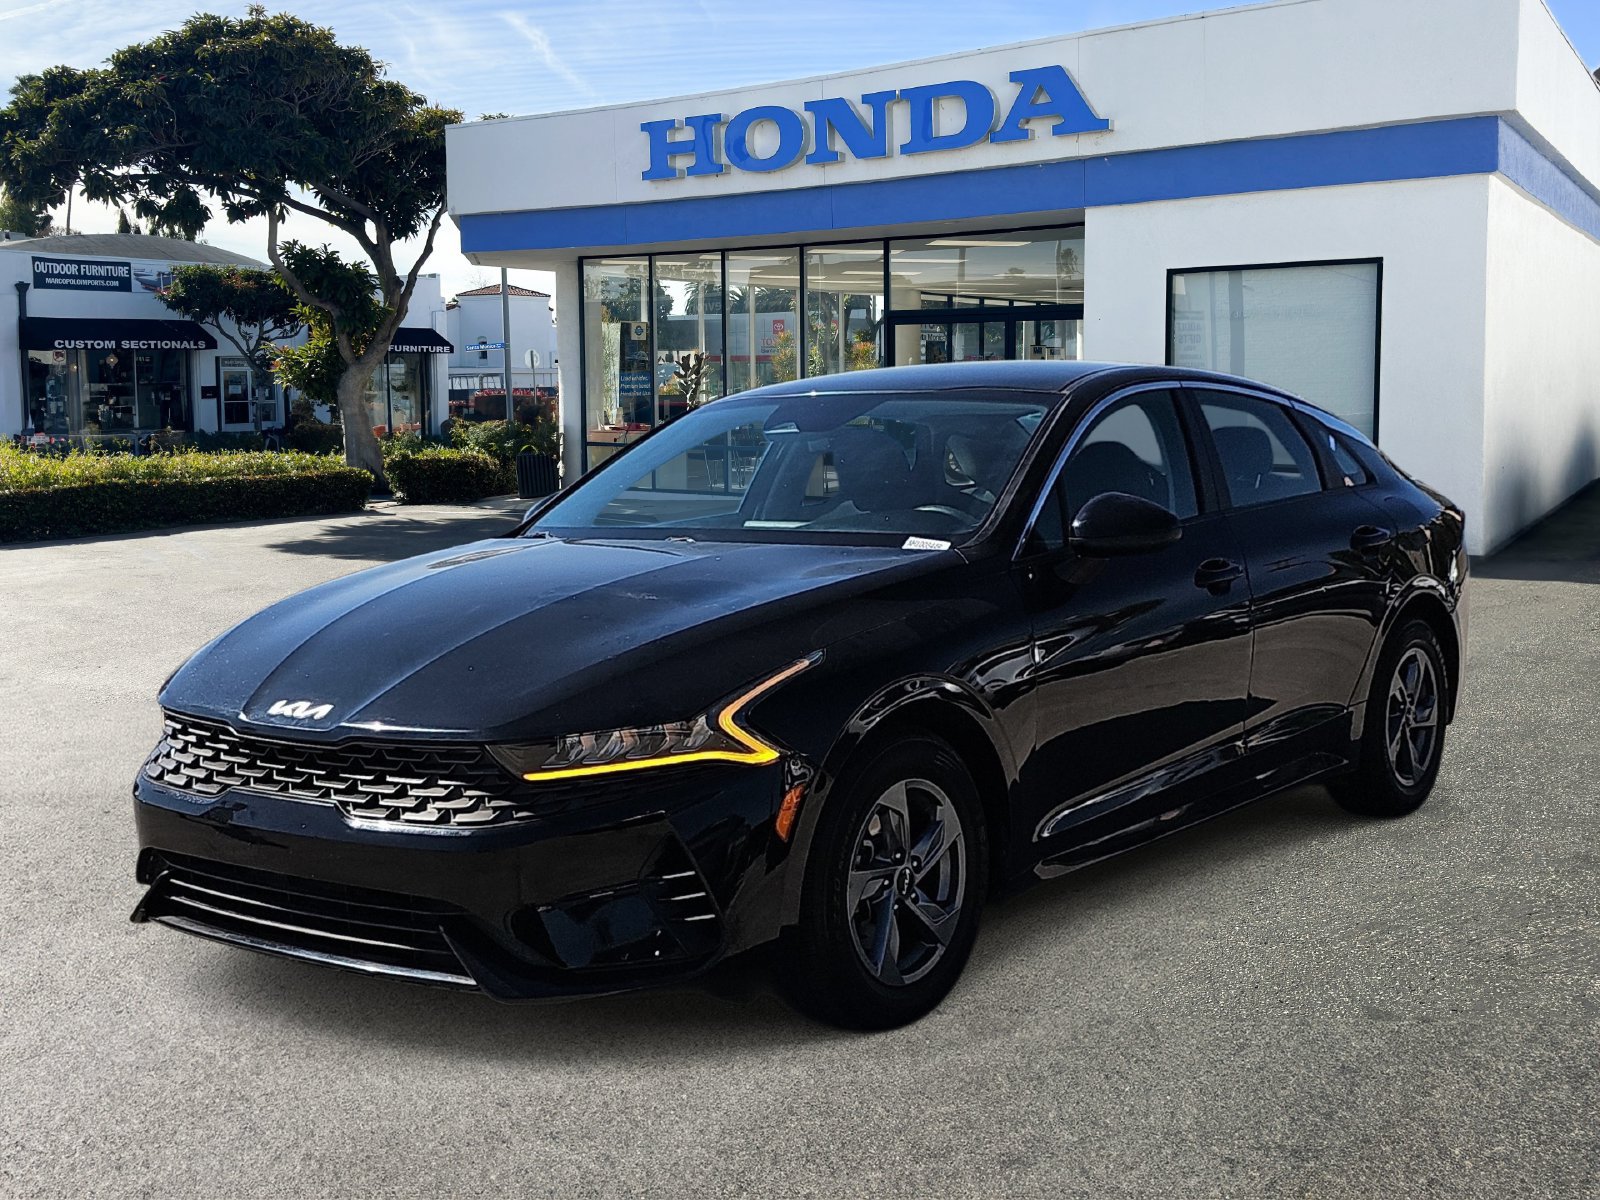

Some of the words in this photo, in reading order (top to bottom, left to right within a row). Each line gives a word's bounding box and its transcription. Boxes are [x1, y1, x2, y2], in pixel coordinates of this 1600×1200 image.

[641, 65, 1112, 181] HONDA
[34, 261, 78, 275] OUTDOOR
[81, 264, 130, 277] FURNITURE
[45, 277, 119, 287] MARCOPOLOIMPORTS.COM
[54, 339, 116, 349] CUSTOM
[121, 340, 206, 349] SECTIONALS
[388, 344, 451, 353] FURNITURE
[267, 700, 335, 720] KIA
